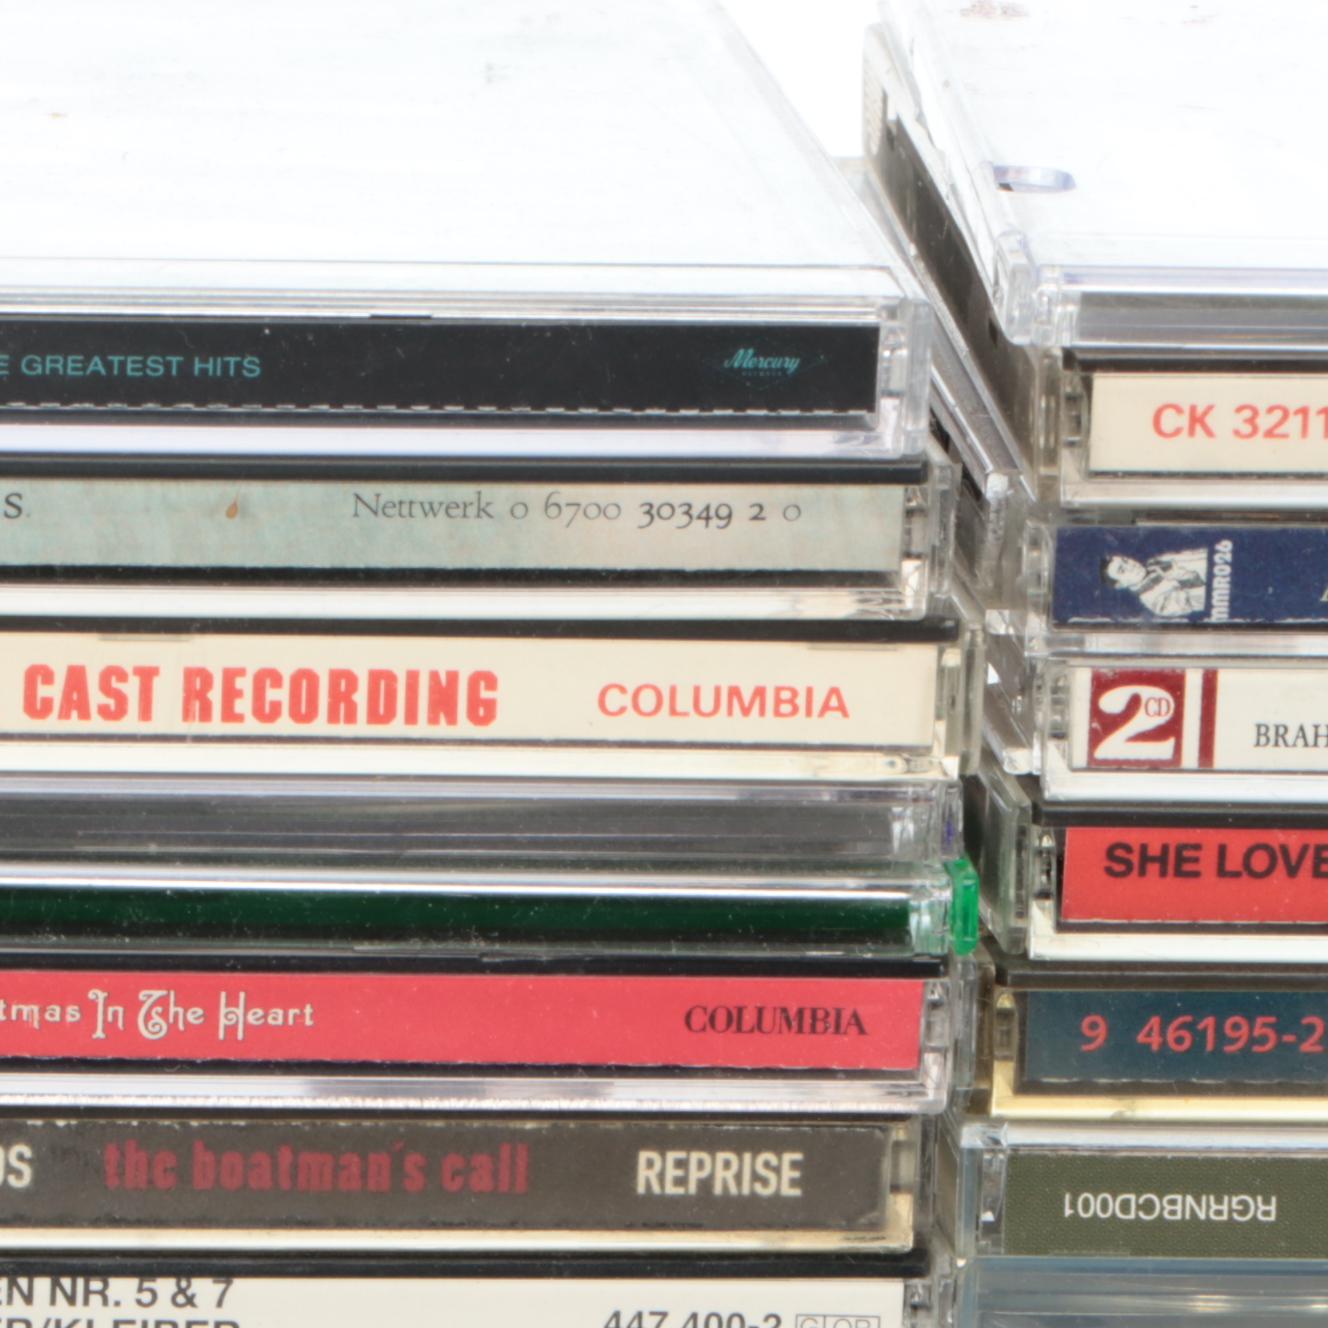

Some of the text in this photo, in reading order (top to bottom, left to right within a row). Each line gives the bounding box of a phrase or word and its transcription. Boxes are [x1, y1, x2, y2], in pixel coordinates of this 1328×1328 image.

[20, 354, 185, 377] GREATEST
[193, 355, 261, 378] HITS
[1152, 403, 1328, 440] CK 3211
[351, 491, 495, 522] Nettwerk
[543, 490, 622, 531] 6700
[637, 501, 734, 530] 30349
[748, 502, 767, 522] 2
[23, 664, 160, 723] CAST
[181, 667, 501, 728] RECORDING
[597, 683, 850, 719] COLUMBIA
[1103, 841, 1203, 879] SHE
[87, 988, 125, 1040] In
[137, 989, 205, 1041] The
[218, 991, 314, 1041] Heart
[683, 1004, 867, 1036] COLUMBIA
[1080, 1014, 1326, 1054] 9 46195-2
[103, 1137, 529, 1194] the boatman's call
[636, 1150, 804, 1197] REPRISE
[1064, 1192, 1277, 1222] RGRNBCD001
[49, 1278, 121, 1307] NR.
[134, 1278, 158, 1308] 5
[169, 1280, 199, 1309] &
[210, 1278, 234, 1309] 7
